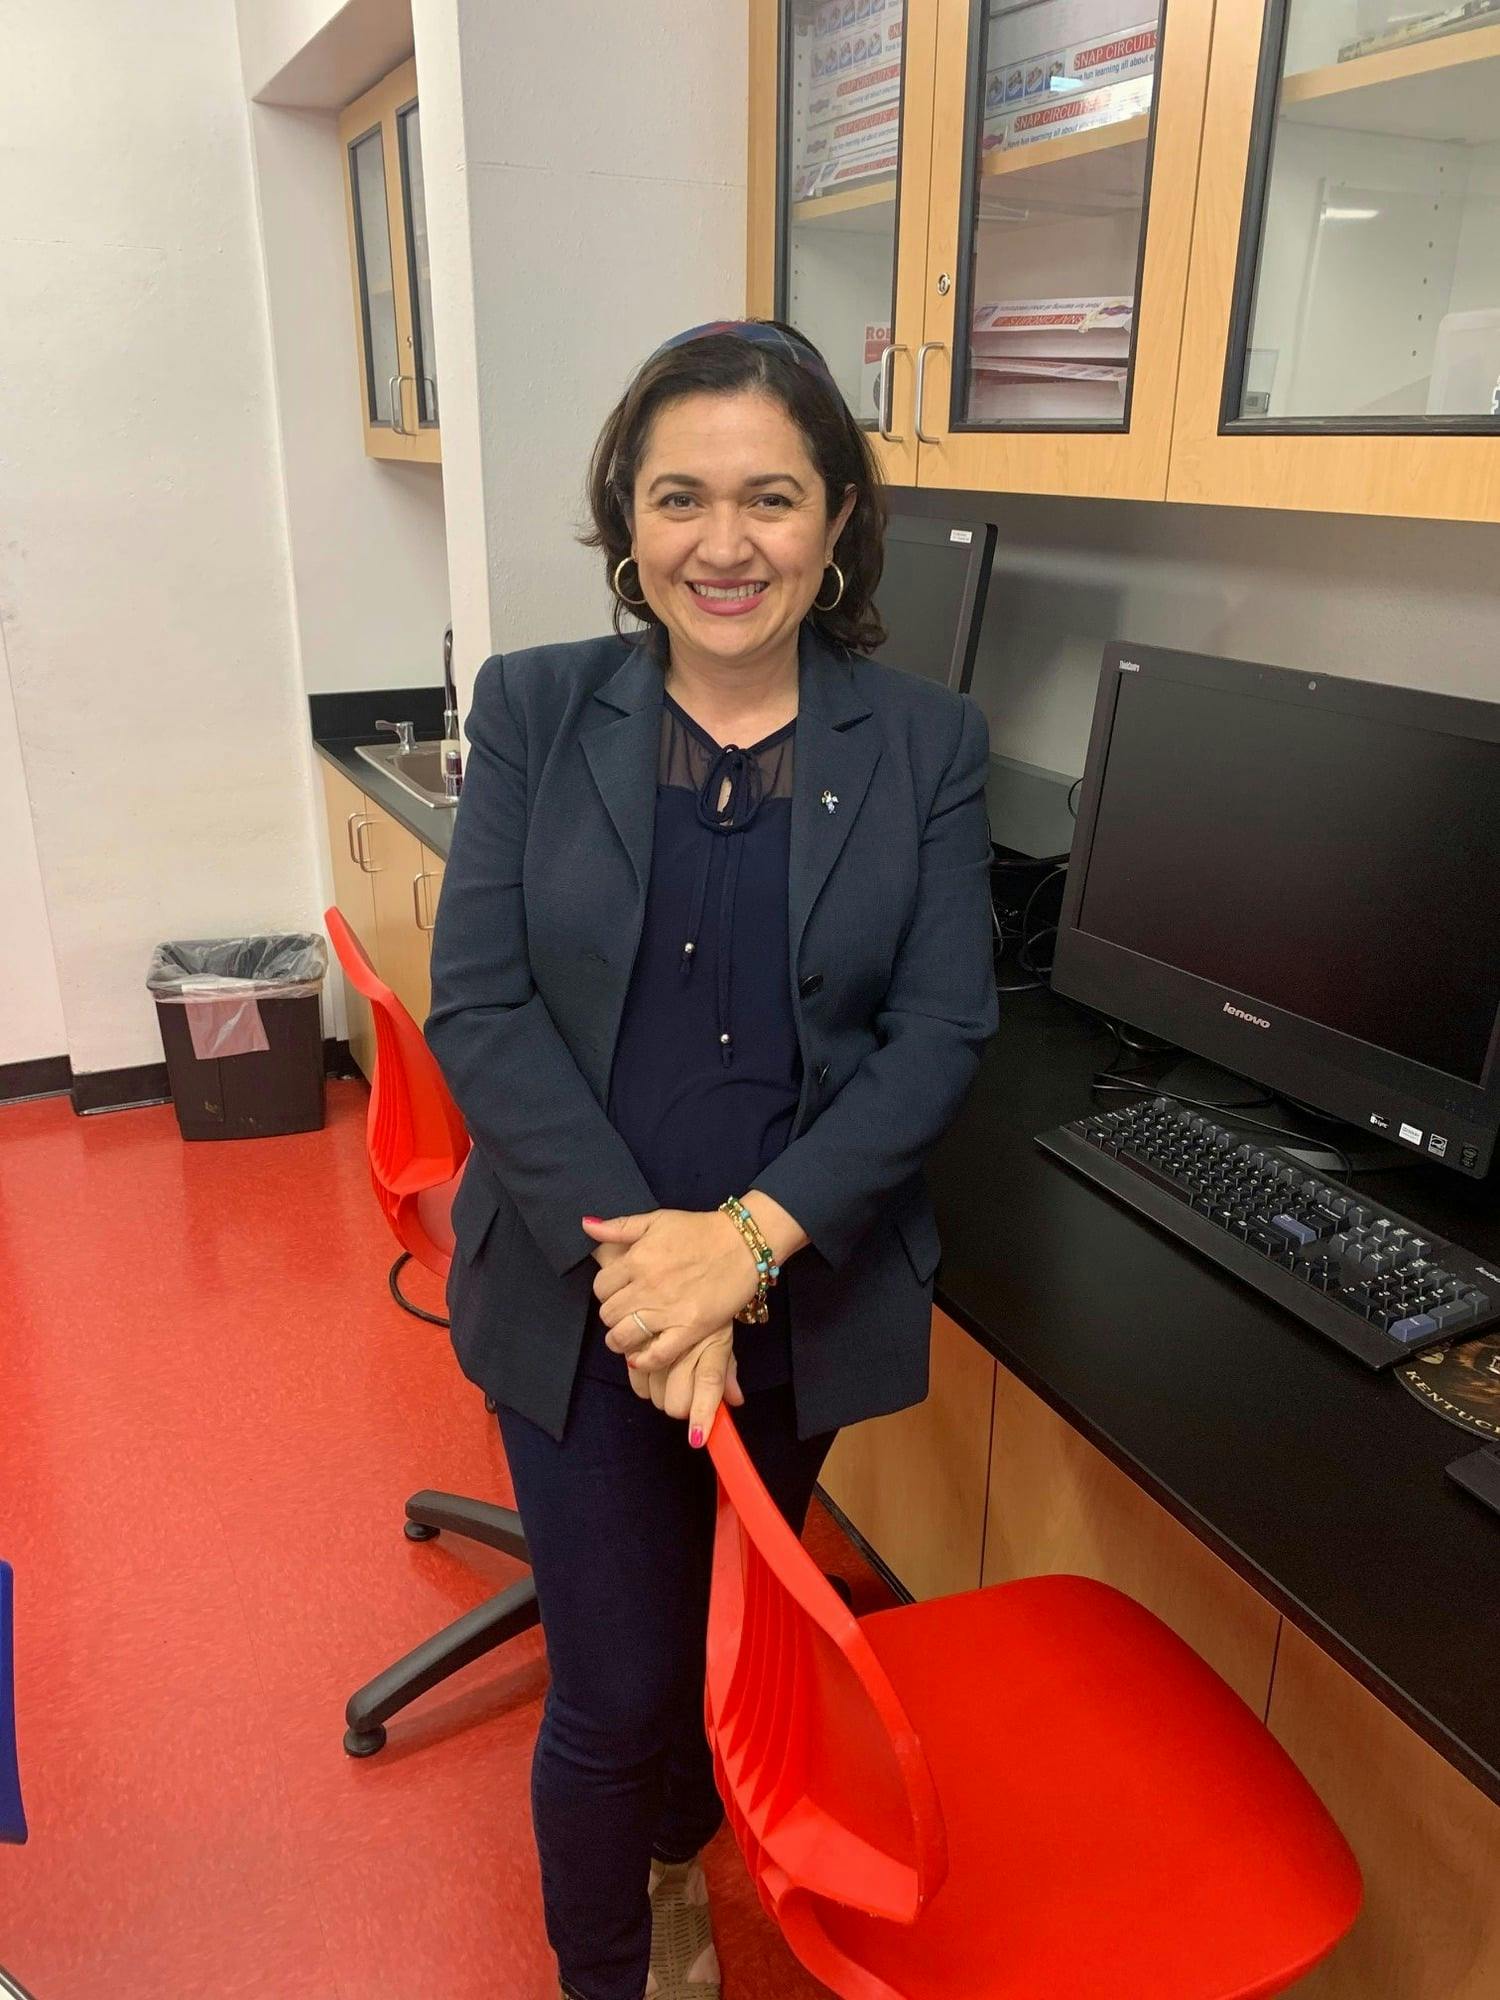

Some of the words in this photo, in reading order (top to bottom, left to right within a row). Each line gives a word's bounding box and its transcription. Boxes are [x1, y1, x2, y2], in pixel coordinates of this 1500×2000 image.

[1074, 49, 1104, 70] SNAP
[1014, 113, 1041, 133] SNAP
[1223, 1001, 1270, 1028] lenovo
